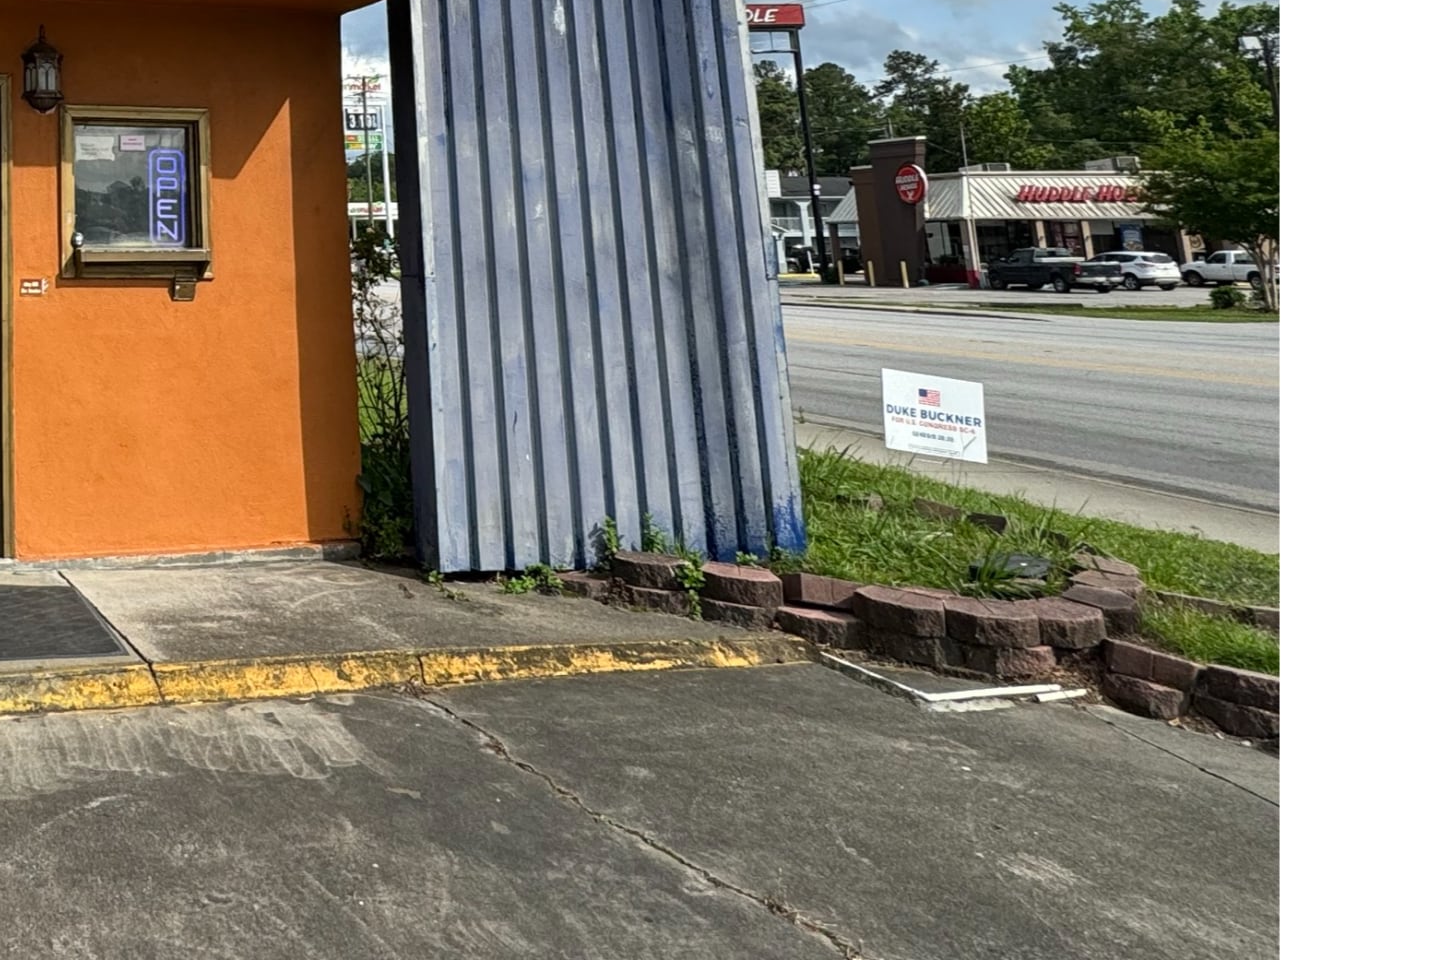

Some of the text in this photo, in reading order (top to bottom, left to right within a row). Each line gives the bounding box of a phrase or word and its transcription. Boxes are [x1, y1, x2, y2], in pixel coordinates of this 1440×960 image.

[156, 156, 178, 241] OPEN
[1017, 184, 1094, 202] HUDDLE
[886, 403, 982, 427] DUKE BUCKNER
[891, 416, 905, 424] FOR
[919, 421, 958, 432] CONGRESS
